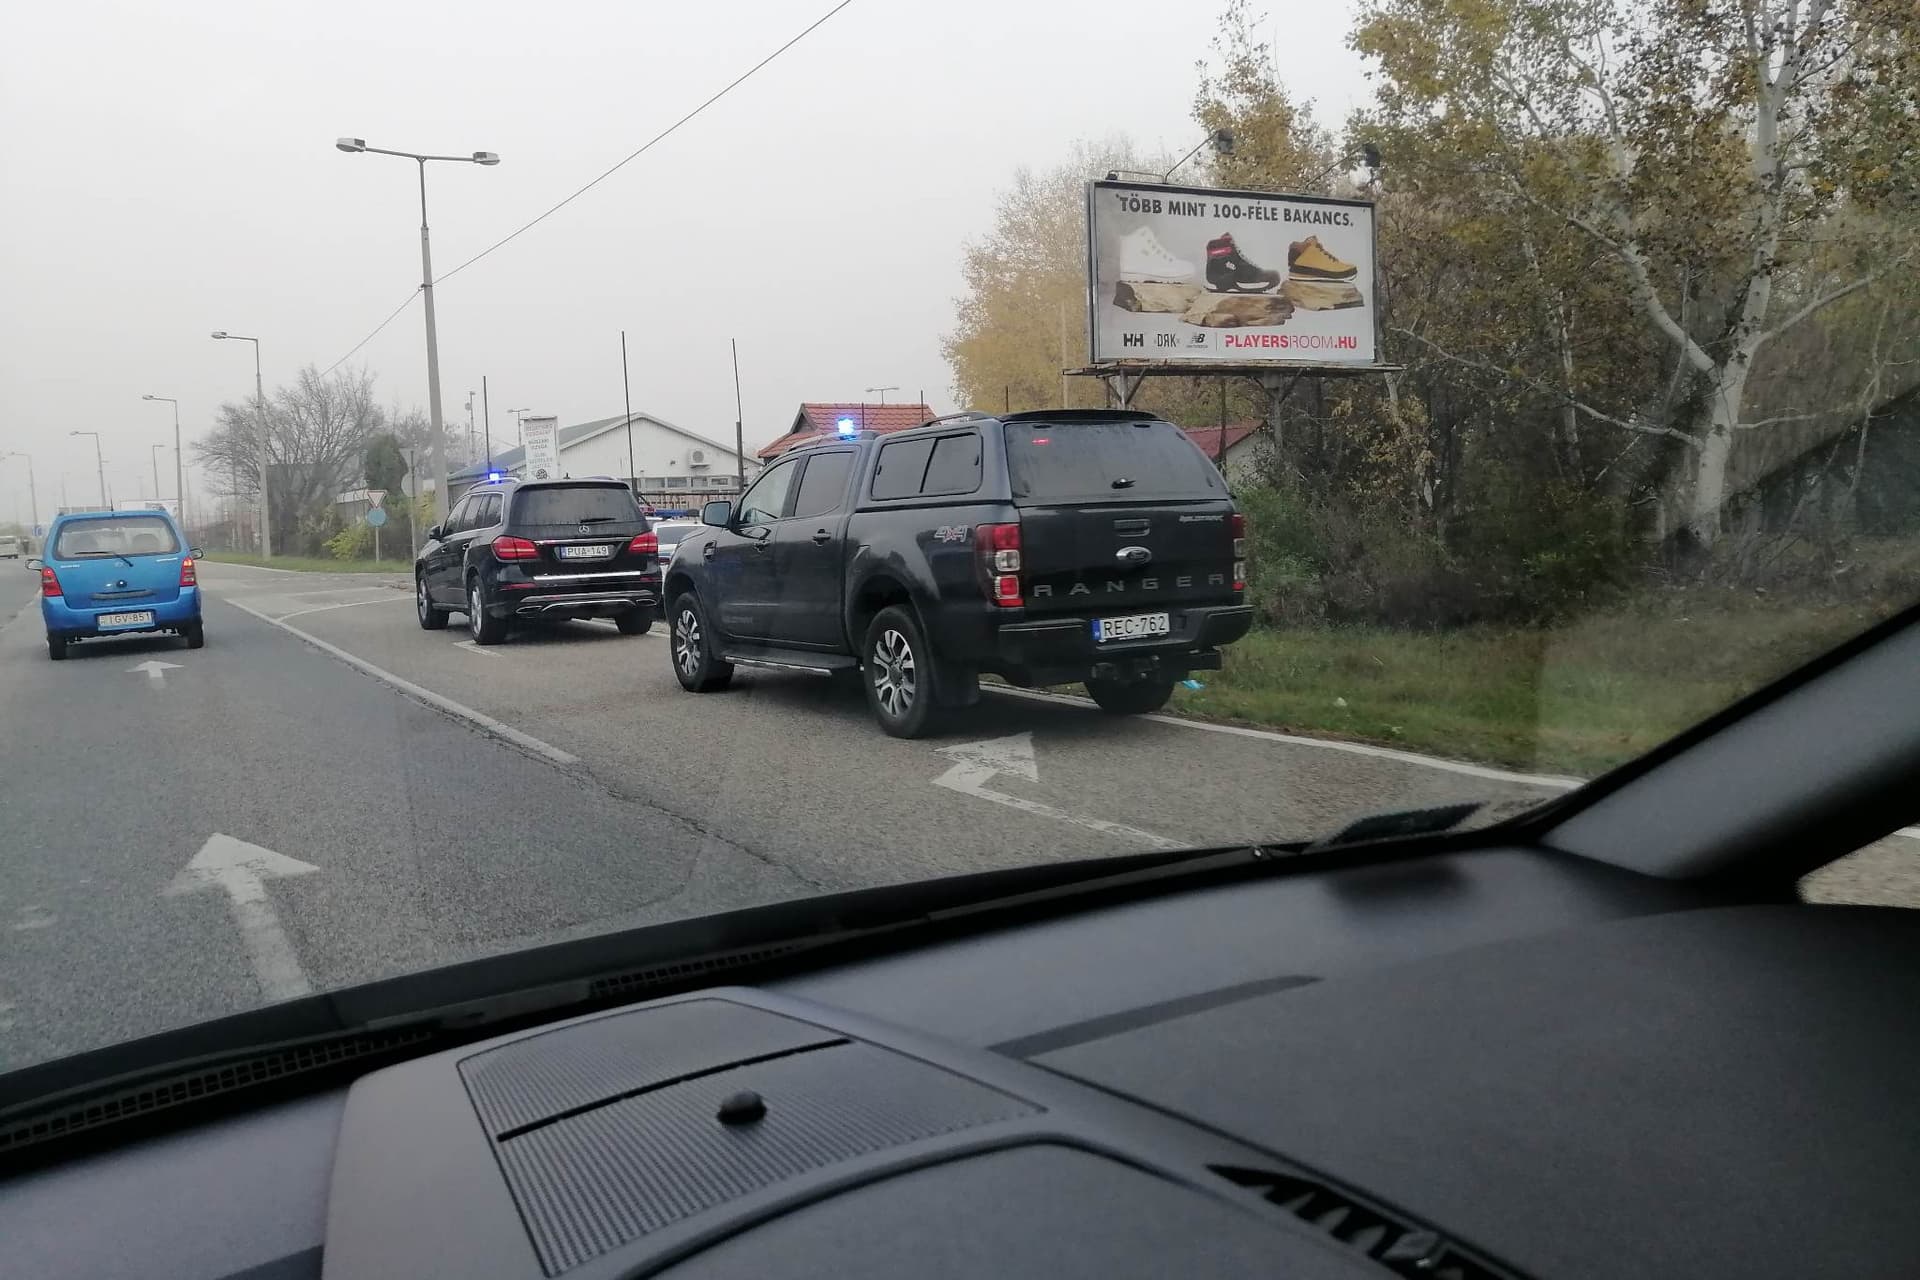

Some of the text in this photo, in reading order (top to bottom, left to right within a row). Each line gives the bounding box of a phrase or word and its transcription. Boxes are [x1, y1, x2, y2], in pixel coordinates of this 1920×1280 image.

[1120, 193, 1354, 227] TÖBB MINT 100-FÉLE BAKANCS.
[1123, 333, 1144, 347] HH
[1225, 334, 1357, 349] PLAYERSROOM.HU
[1033, 573, 1224, 597] RANGER
[1103, 615, 1166, 636] REC-762
